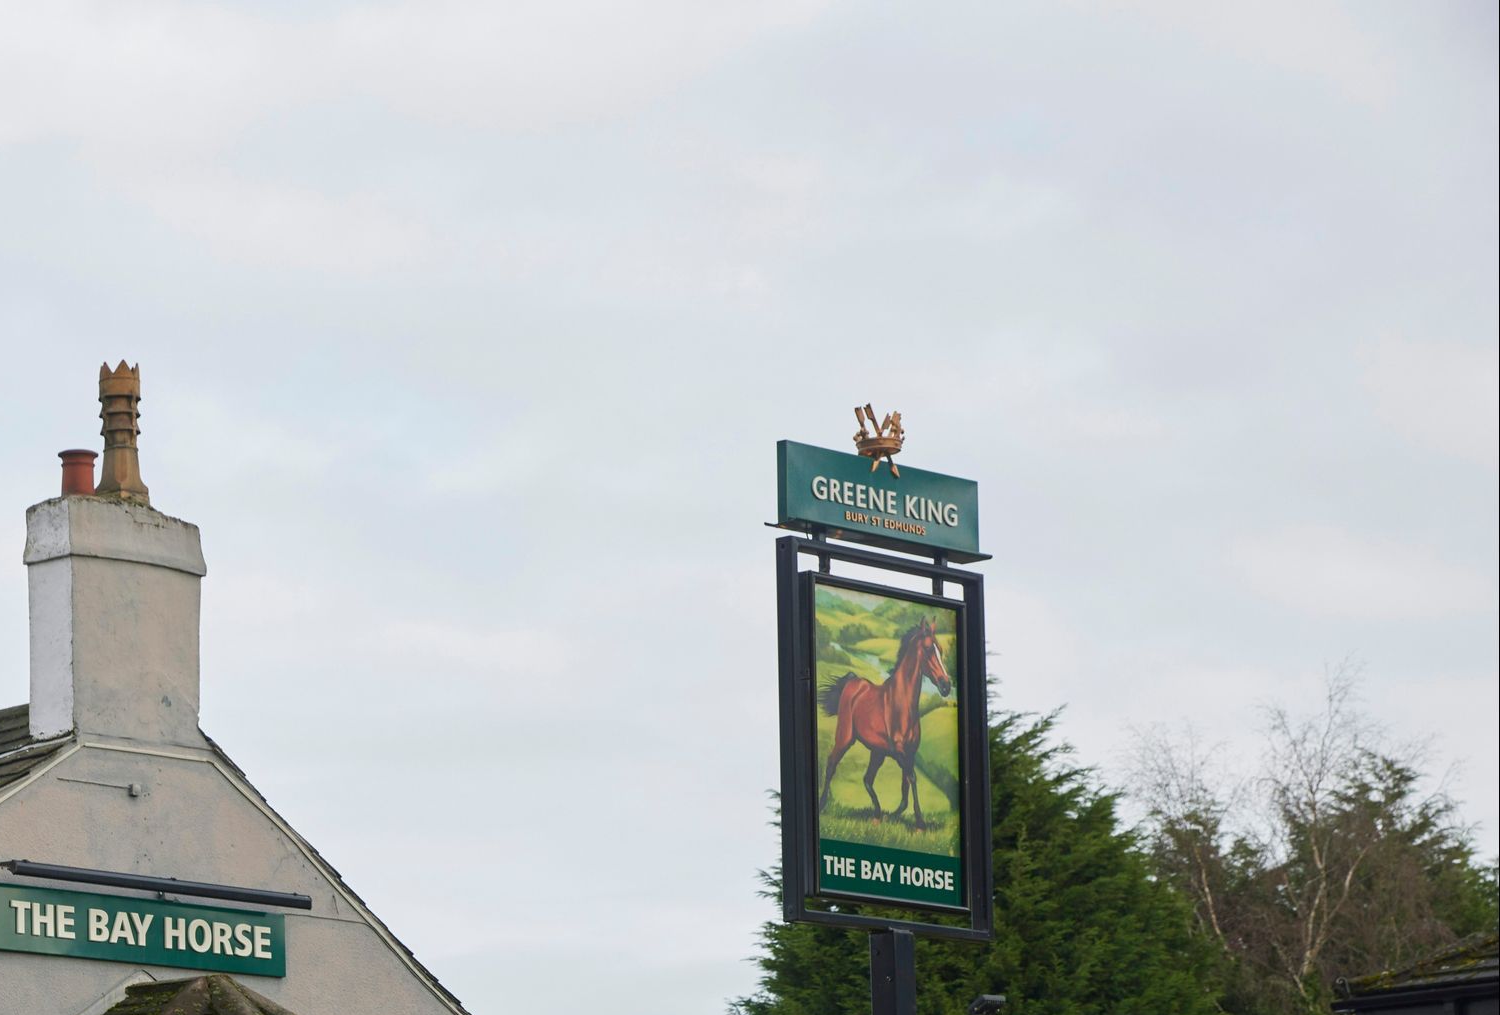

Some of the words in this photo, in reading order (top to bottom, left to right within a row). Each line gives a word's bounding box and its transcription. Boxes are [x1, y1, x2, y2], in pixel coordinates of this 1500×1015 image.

[811, 475, 898, 515] GREENE
[905, 494, 959, 527] KING
[845, 510, 869, 524] BURY
[870, 516, 881, 527] ST
[884, 518, 927, 536] EDMUNDS
[823, 855, 856, 878] THE
[860, 860, 895, 883] BAY
[900, 865, 954, 891] HORSE
[9, 900, 76, 940] THE
[88, 908, 154, 947] BAY
[164, 916, 272, 959] HORSE
